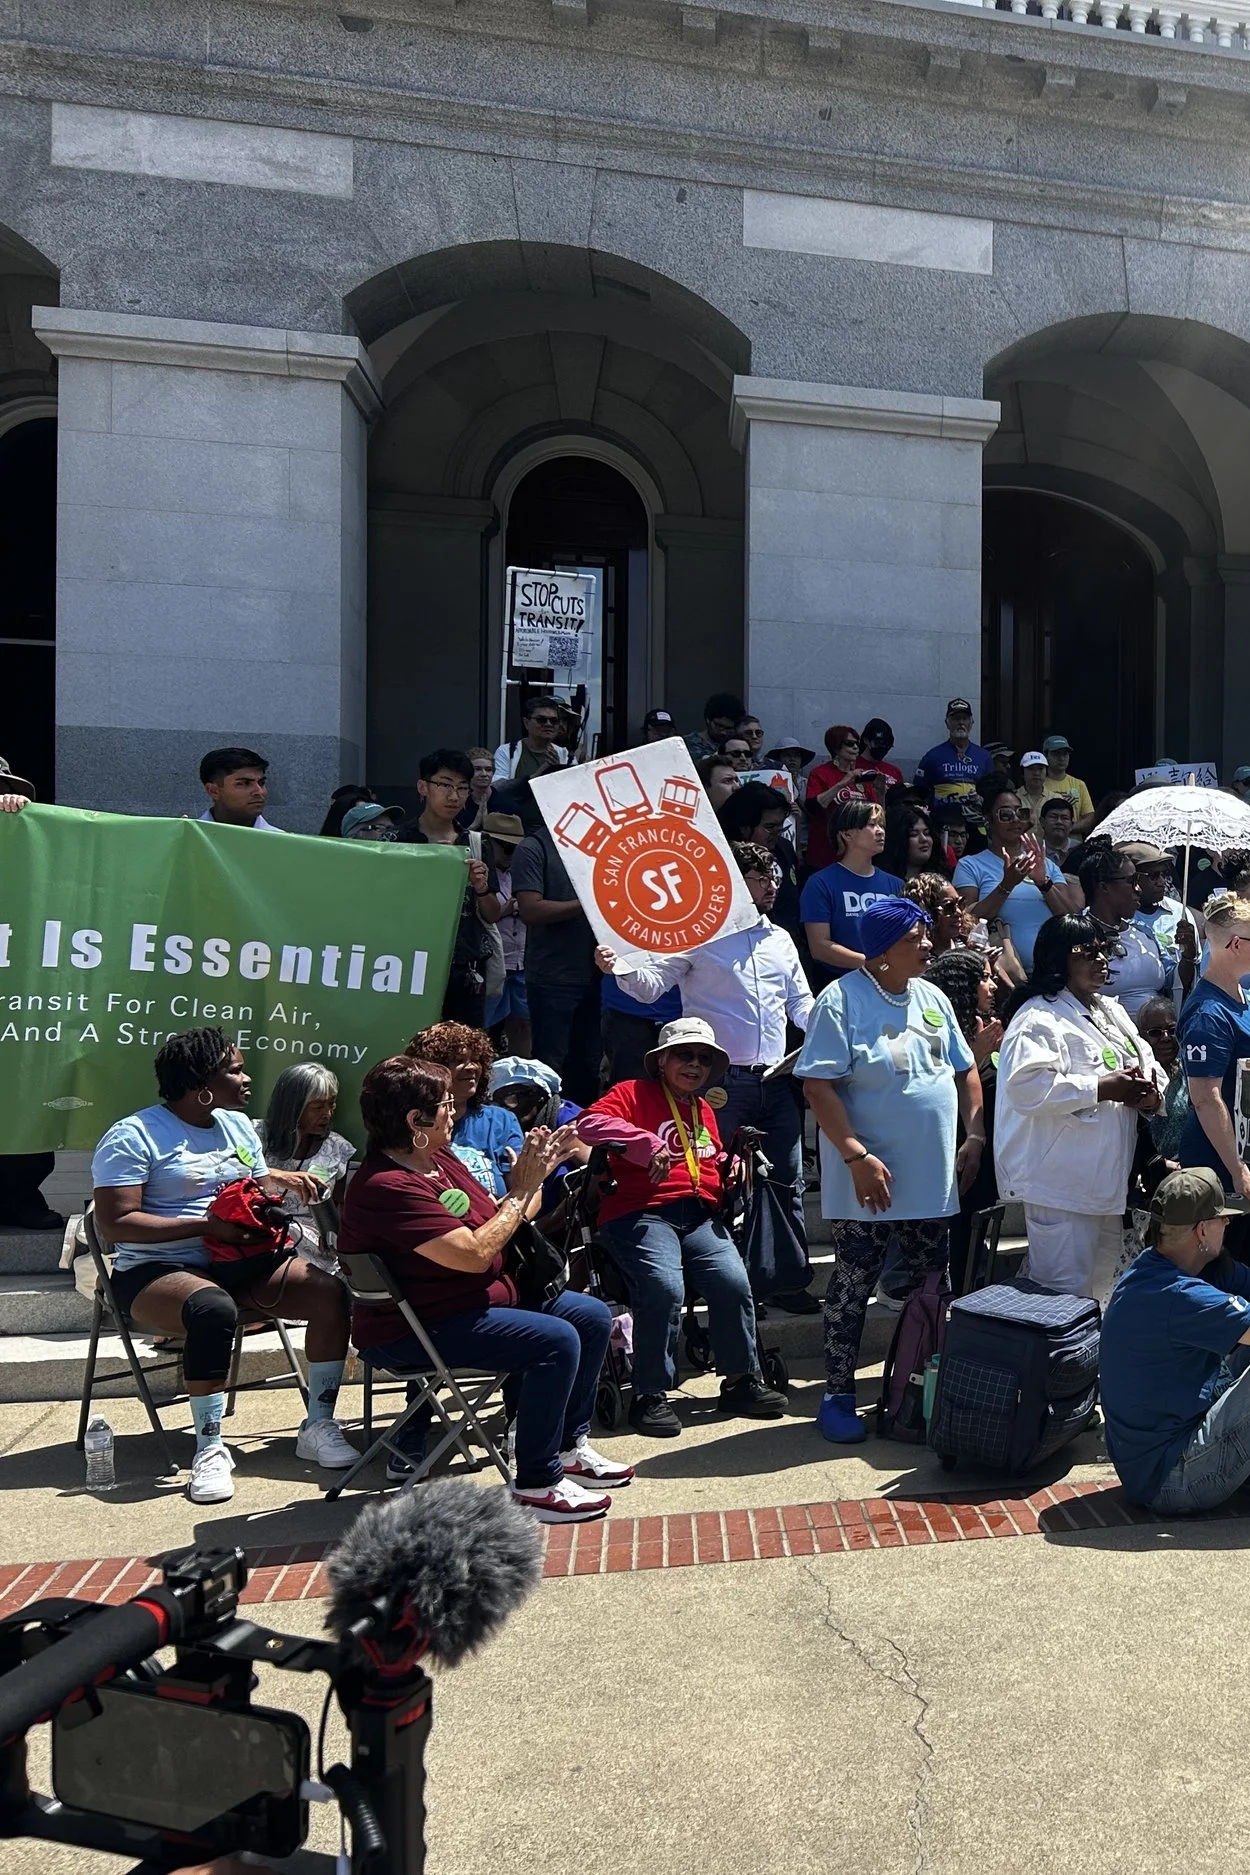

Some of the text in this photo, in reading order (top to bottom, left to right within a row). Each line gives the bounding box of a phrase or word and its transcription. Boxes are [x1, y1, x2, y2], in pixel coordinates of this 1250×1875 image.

[520, 581, 559, 607] STOP
[551, 595, 585, 616] CUTS
[519, 611, 585, 637] TRANSIT!
[942, 762, 979, 774] Trilogy
[618, 828, 706, 859] FRANCISCO
[603, 854, 624, 887] SAN
[641, 861, 684, 911] SF
[691, 884, 726, 937] RIDERS
[621, 915, 689, 947] TRANSIT
[42, 920, 103, 969] Is
[129, 923, 429, 996] Essential
[107, 993, 156, 1015] For
[170, 995, 254, 1021] Clean
[268, 1002, 322, 1031] Air,
[0, 1021, 369, 1065] And A Str Economy
